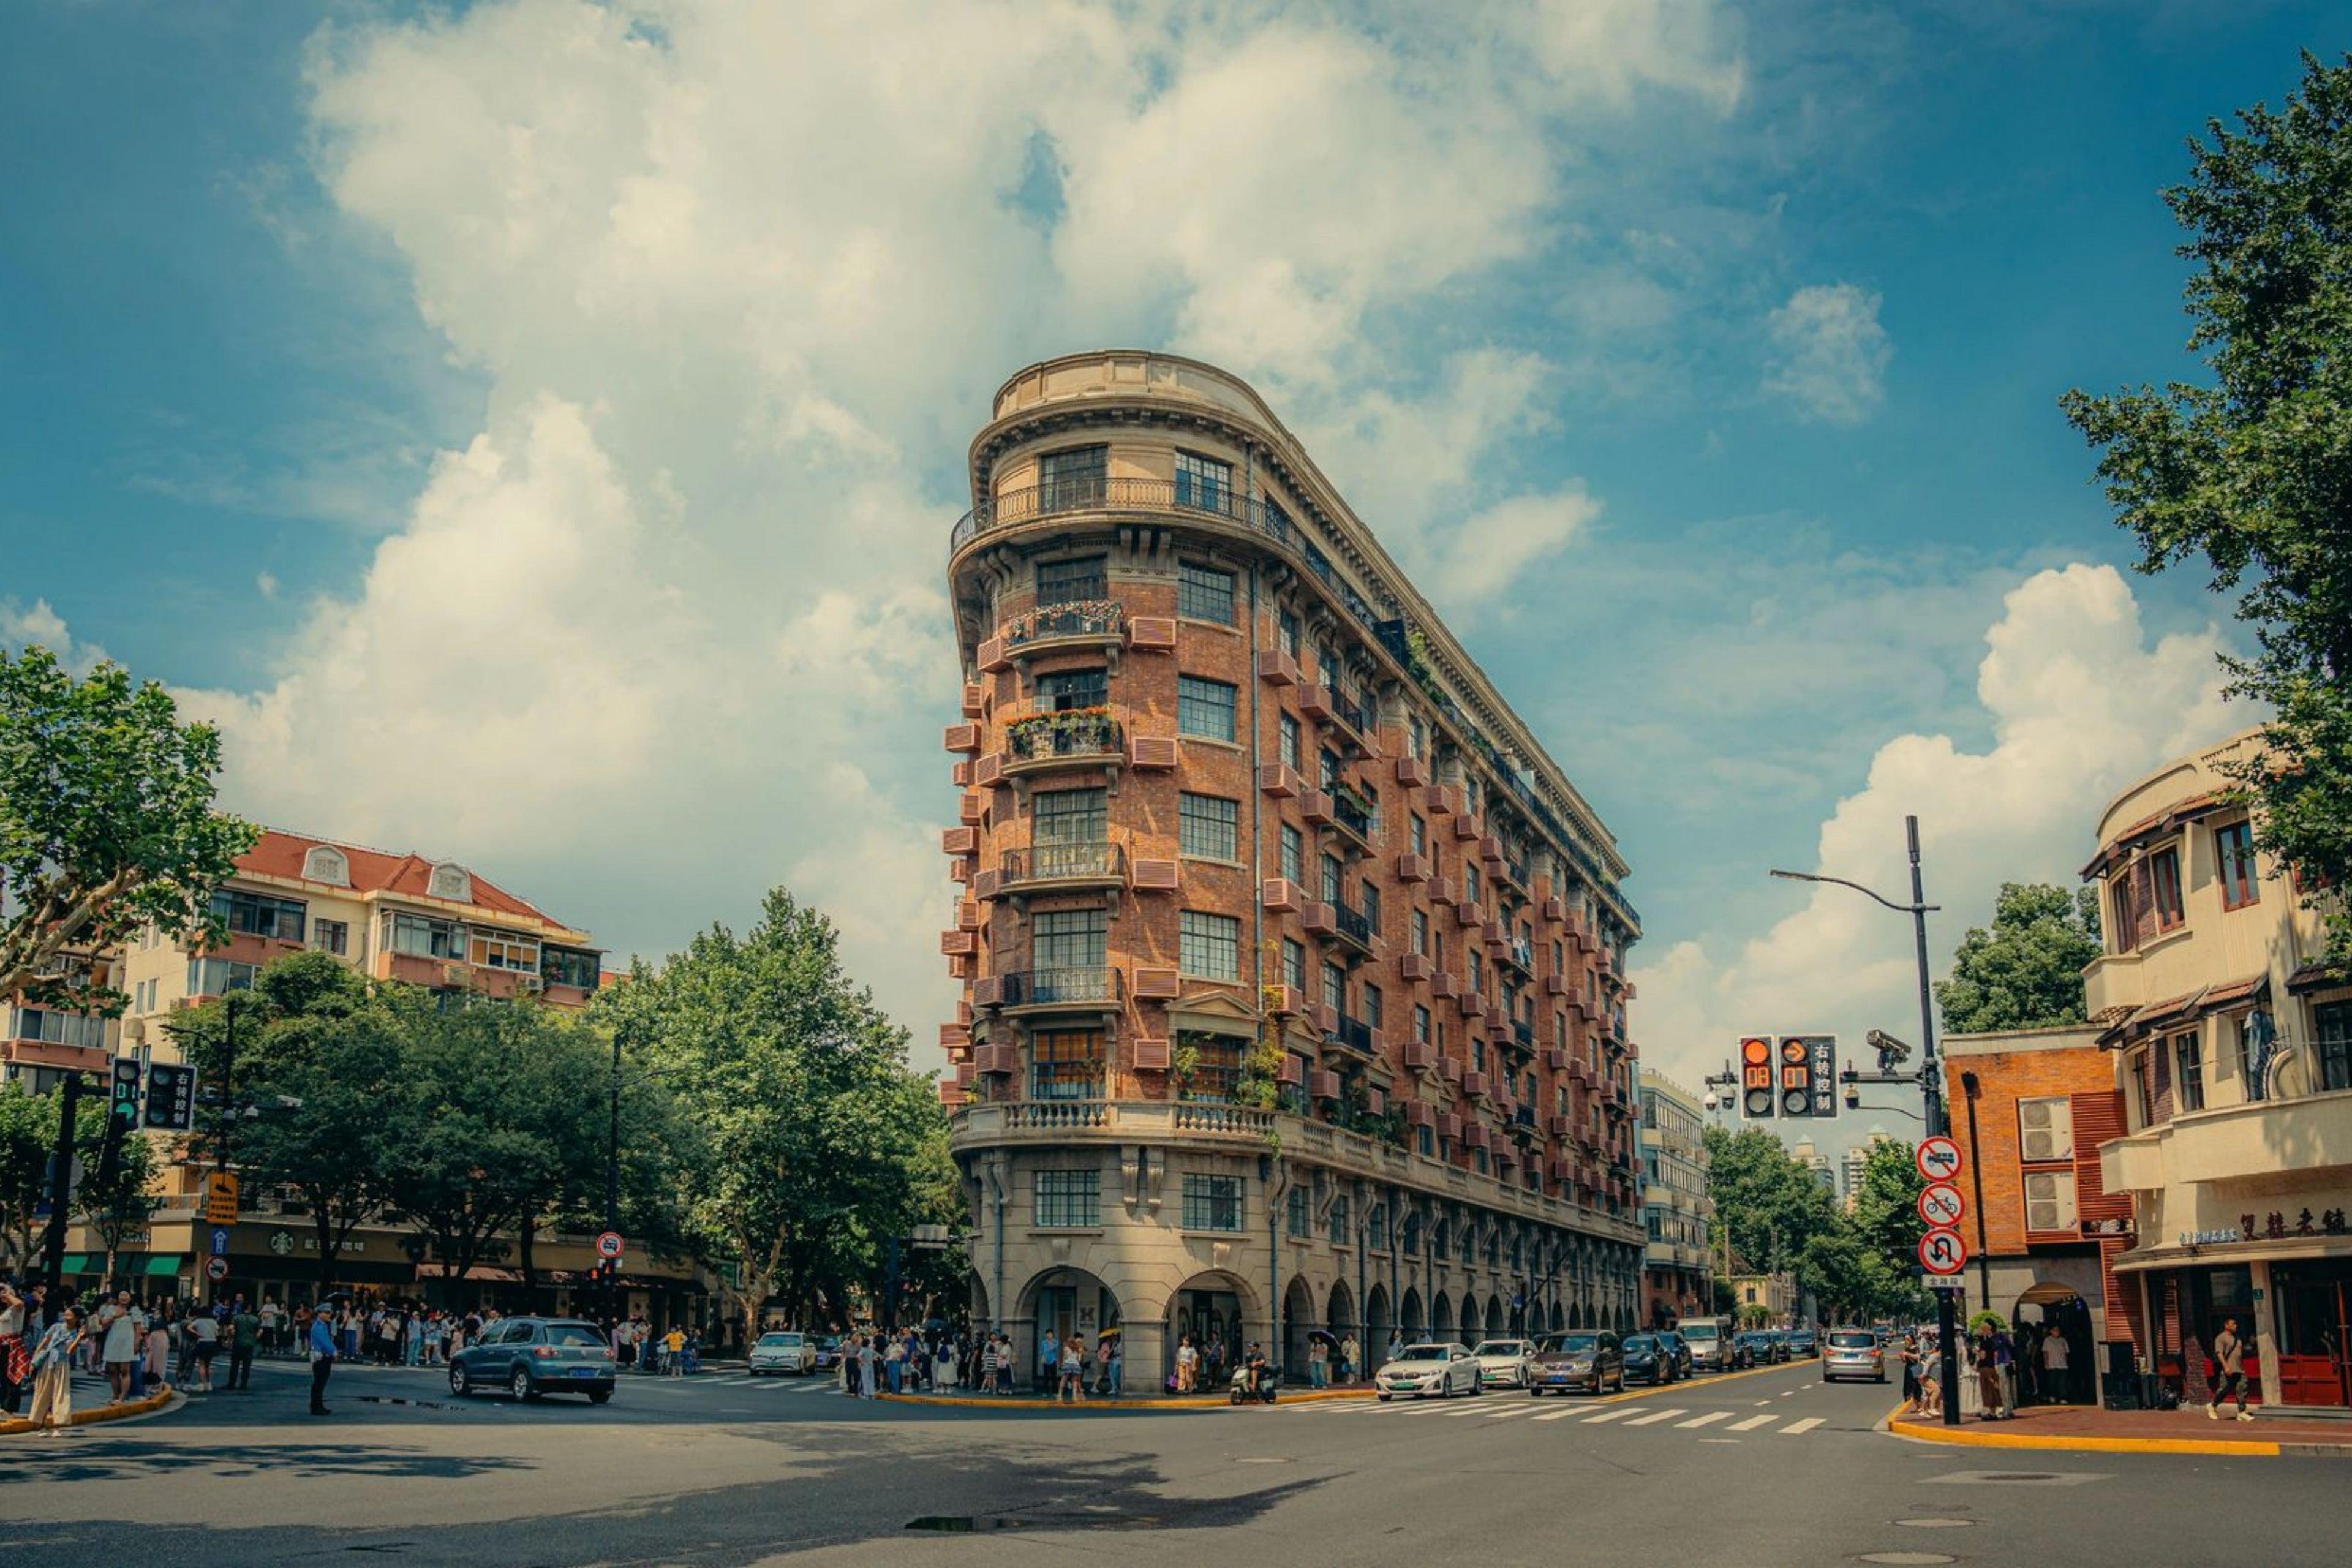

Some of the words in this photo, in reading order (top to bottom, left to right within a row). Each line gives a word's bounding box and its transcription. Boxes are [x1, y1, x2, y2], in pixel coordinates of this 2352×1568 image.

[1746, 1066, 1769, 1089] 08
[1784, 1066, 1807, 1089] 07
[1815, 1044, 1830, 1110] 右转控制
[173, 1073, 189, 1124] 右转控制
